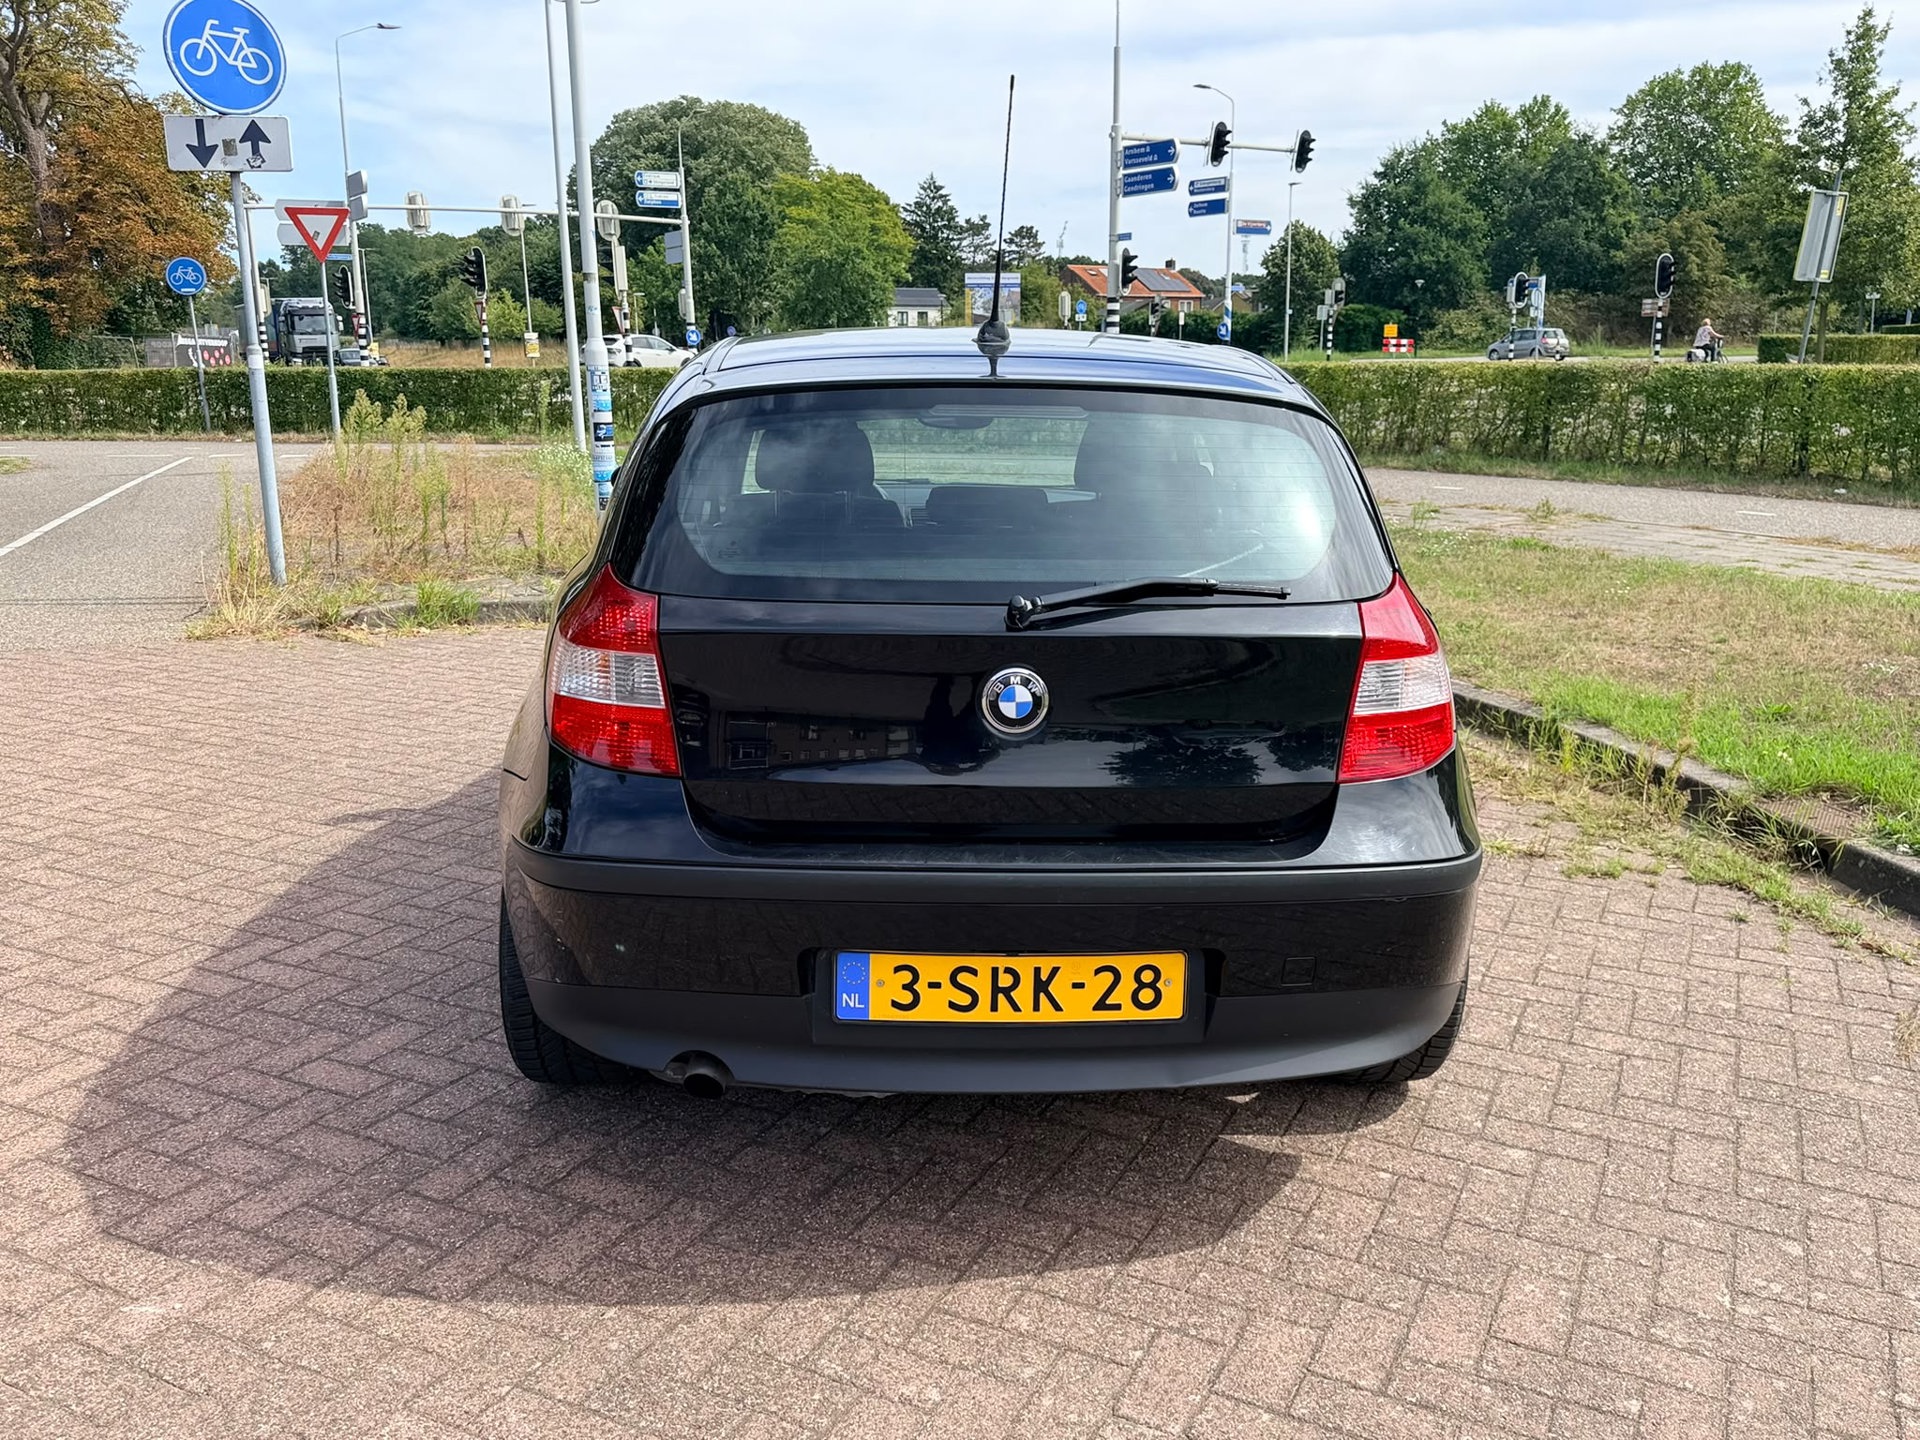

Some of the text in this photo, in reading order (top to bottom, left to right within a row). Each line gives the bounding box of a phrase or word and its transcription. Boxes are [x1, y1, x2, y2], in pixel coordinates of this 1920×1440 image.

[1124, 147, 1146, 156] Arnhem
[992, 675, 1040, 695] BMW
[890, 964, 1163, 1013] 3-SRK-28
[842, 993, 865, 1009] NL
